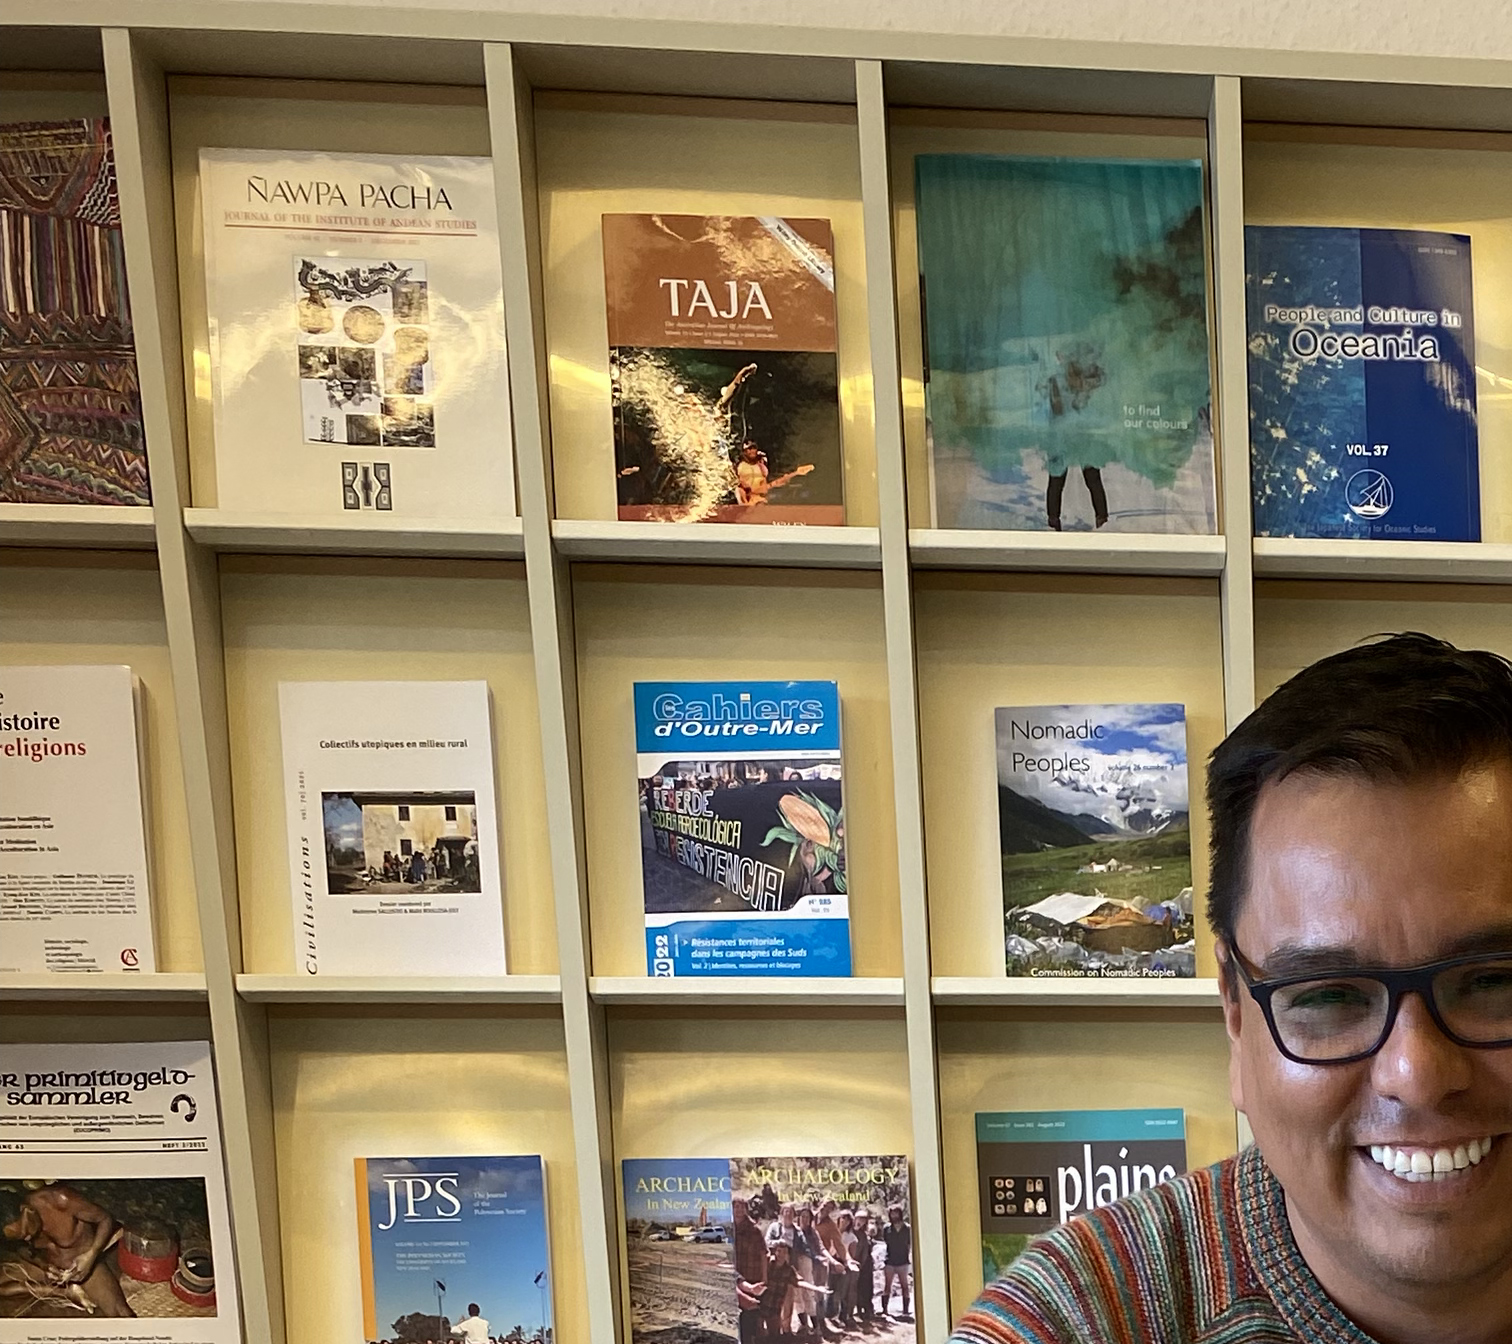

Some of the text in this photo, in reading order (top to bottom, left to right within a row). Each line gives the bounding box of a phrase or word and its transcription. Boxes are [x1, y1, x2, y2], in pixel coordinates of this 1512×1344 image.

[247, 176, 452, 210] ÑAWPA PACHA
[224, 211, 270, 222] JOURNAL
[275, 213, 287, 222] OF
[290, 214, 311, 223] THE
[316, 215, 370, 226] INSTITUTE
[373, 216, 386, 227] OF
[435, 220, 477, 229] STUDIES
[659, 279, 773, 319] TAJA
[1266, 306, 1461, 327] People and Culture in
[1292, 329, 1439, 360] Oceania
[1138, 405, 1160, 417] find
[1124, 418, 1189, 430] our colours
[1373, 445, 1389, 456] 37
[653, 693, 824, 722] Cahiers
[654, 720, 824, 737] d'Outre-Mer
[1011, 719, 1105, 740] Nomadic
[0, 738, 87, 762] eligions
[320, 739, 360, 749] Collectifs
[361, 740, 404, 750] utopiques
[419, 739, 446, 748] milieu
[447, 739, 468, 748] rural
[1012, 752, 1090, 777] Peoples
[670, 833, 785, 911] RESISTENCIA
[691, 938, 784, 947] Résistances territoriales
[691, 948, 807, 959] dans les campagnes des Suds
[1031, 968, 1084, 977] Commission
[1101, 966, 1141, 977] Nomadic
[1142, 968, 1176, 978] Peoples
[746, 1166, 899, 1186] ARCHAEOLOGY
[378, 1177, 461, 1230] JPS
[647, 1198, 688, 1210] In New
[823, 1188, 870, 1202] Zealand
